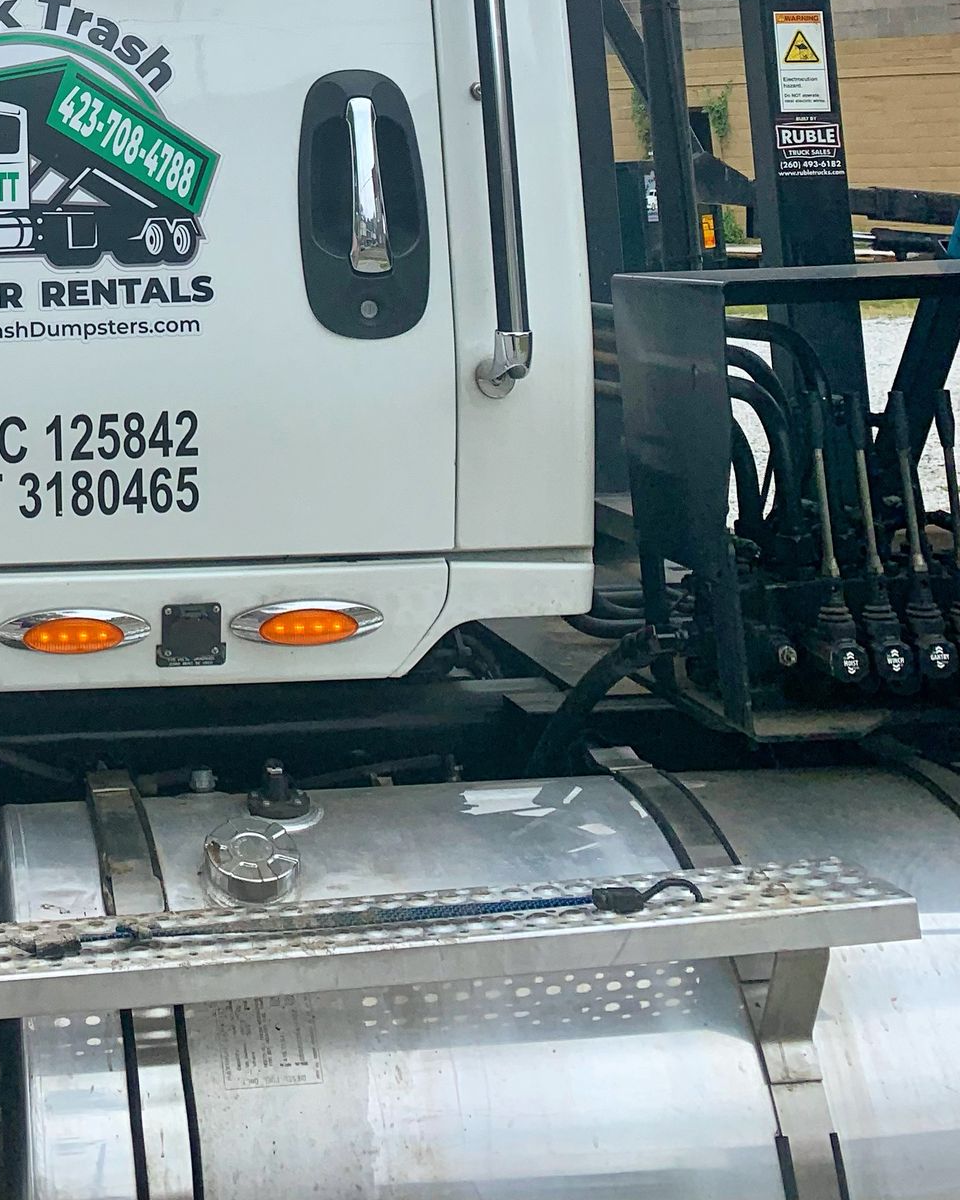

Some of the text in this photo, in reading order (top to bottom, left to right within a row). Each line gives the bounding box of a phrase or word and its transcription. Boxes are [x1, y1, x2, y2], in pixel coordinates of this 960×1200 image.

[58, 85, 196, 199] 423-708-4788
[781, 128, 835, 144] RUBLE
[780, 160, 841, 169] (260) 493-6182
[41, 276, 214, 307] RENTALS
[46, 410, 199, 461] 125842
[18, 467, 200, 519] 3180465
[843, 659, 859, 667] HOIST
[886, 656, 905, 664] WINCH
